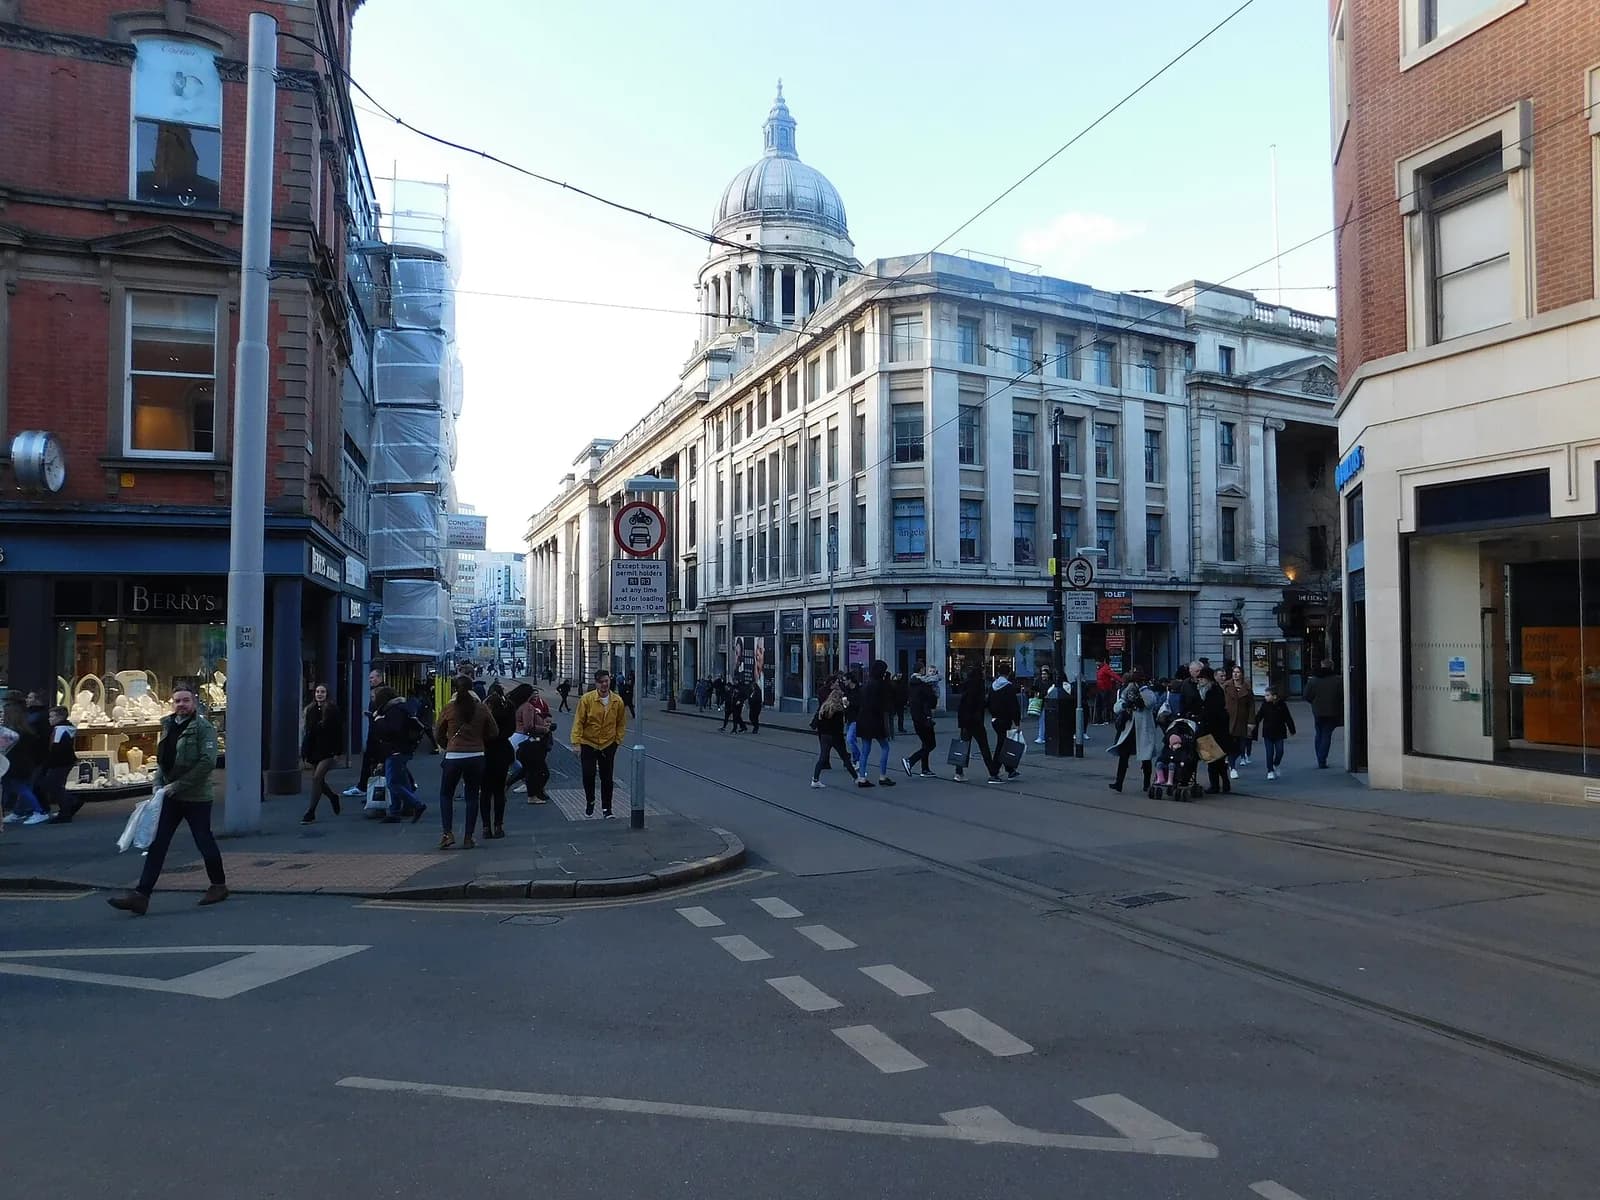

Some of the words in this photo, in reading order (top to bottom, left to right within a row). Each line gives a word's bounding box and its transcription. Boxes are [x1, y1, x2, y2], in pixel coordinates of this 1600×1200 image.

[132, 586, 216, 612] BERRY'S
[998, 615, 1014, 628] PRET
[1016, 616, 1022, 628] A
